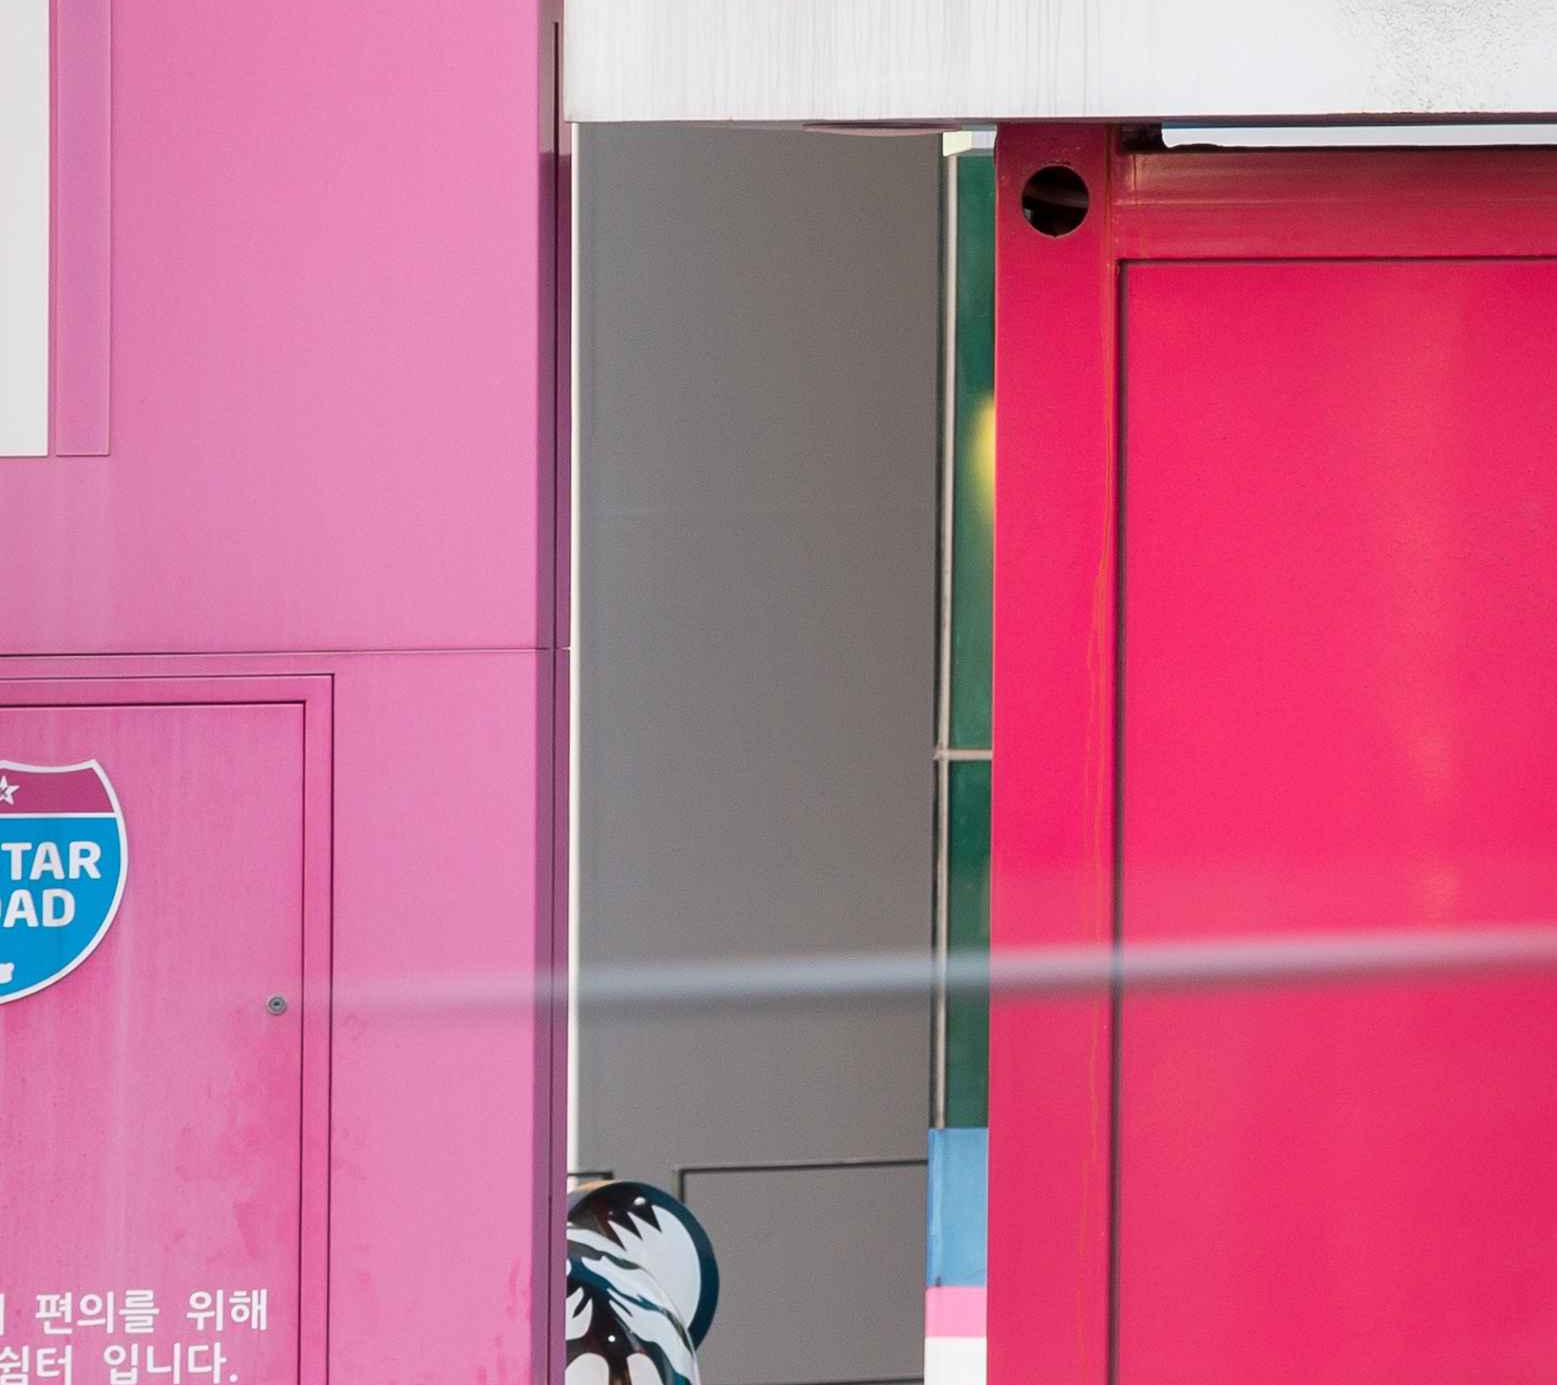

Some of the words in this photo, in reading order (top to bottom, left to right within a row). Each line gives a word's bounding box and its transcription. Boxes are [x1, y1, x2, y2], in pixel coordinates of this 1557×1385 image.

[0, 888, 76, 928] AD
[35, 1289, 161, 1336] 편의를
[186, 1288, 269, 1333] 위해
